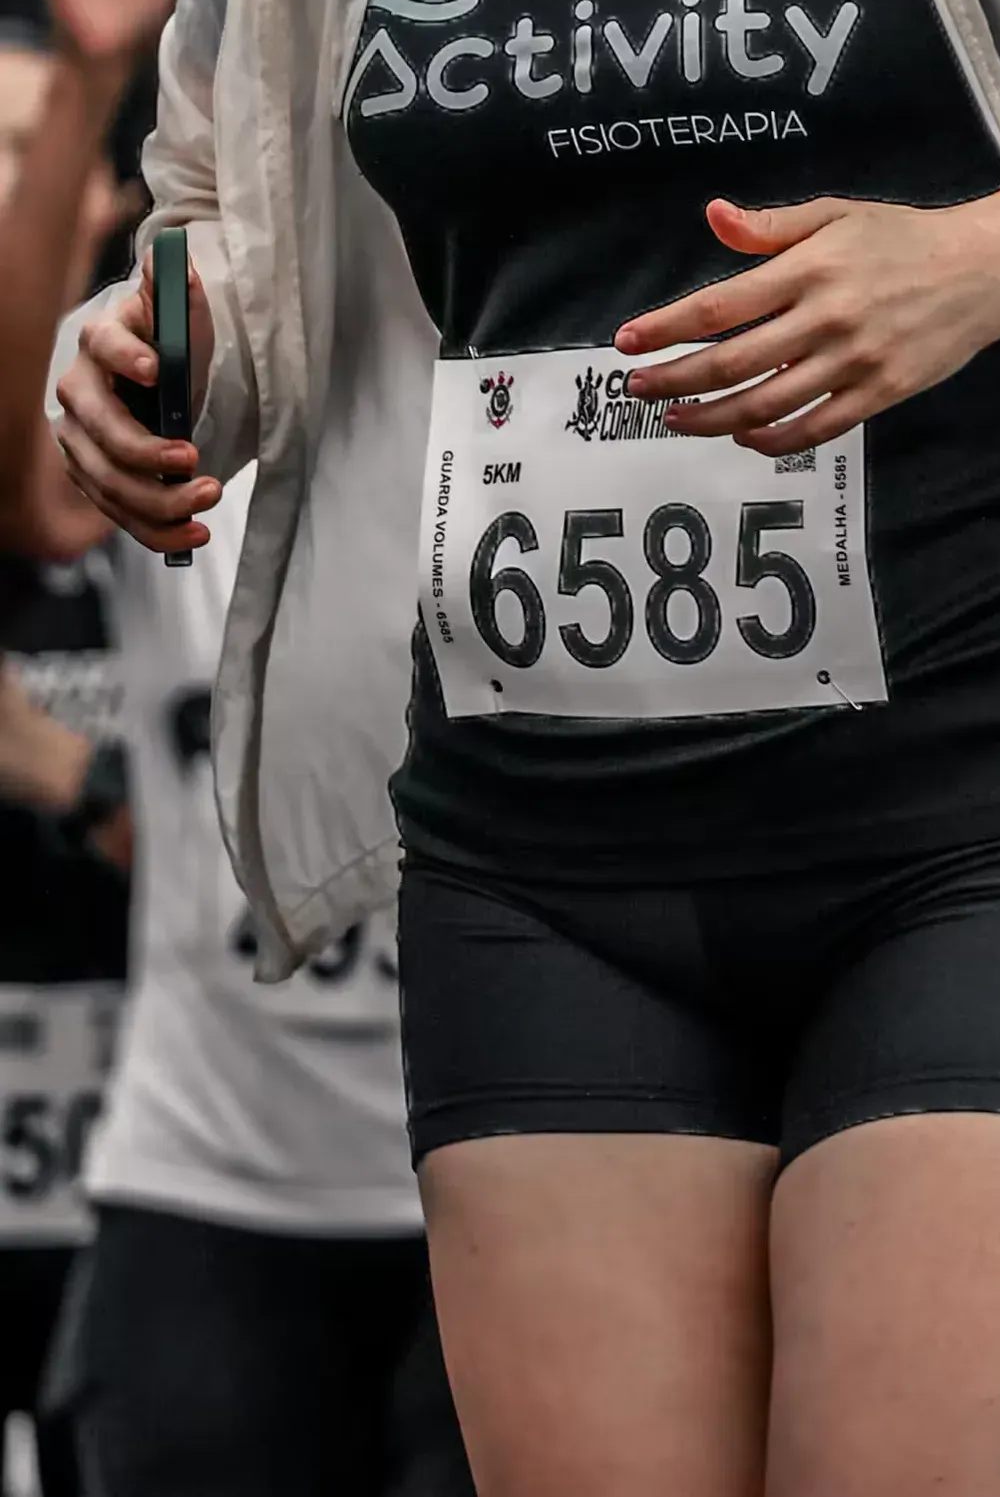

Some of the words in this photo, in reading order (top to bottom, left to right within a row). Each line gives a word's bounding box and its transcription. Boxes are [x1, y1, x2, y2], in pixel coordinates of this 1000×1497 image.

[547, 110, 809, 158] FISIOTERAPIA
[435, 450, 454, 518] GUARDA
[482, 462, 521, 486] 5KM
[834, 455, 847, 491] 6585
[431, 520, 447, 599] VOLUMES
[834, 504, 851, 586] MEDALHA
[469, 500, 817, 669] 6585
[436, 611, 454, 644] 6585
